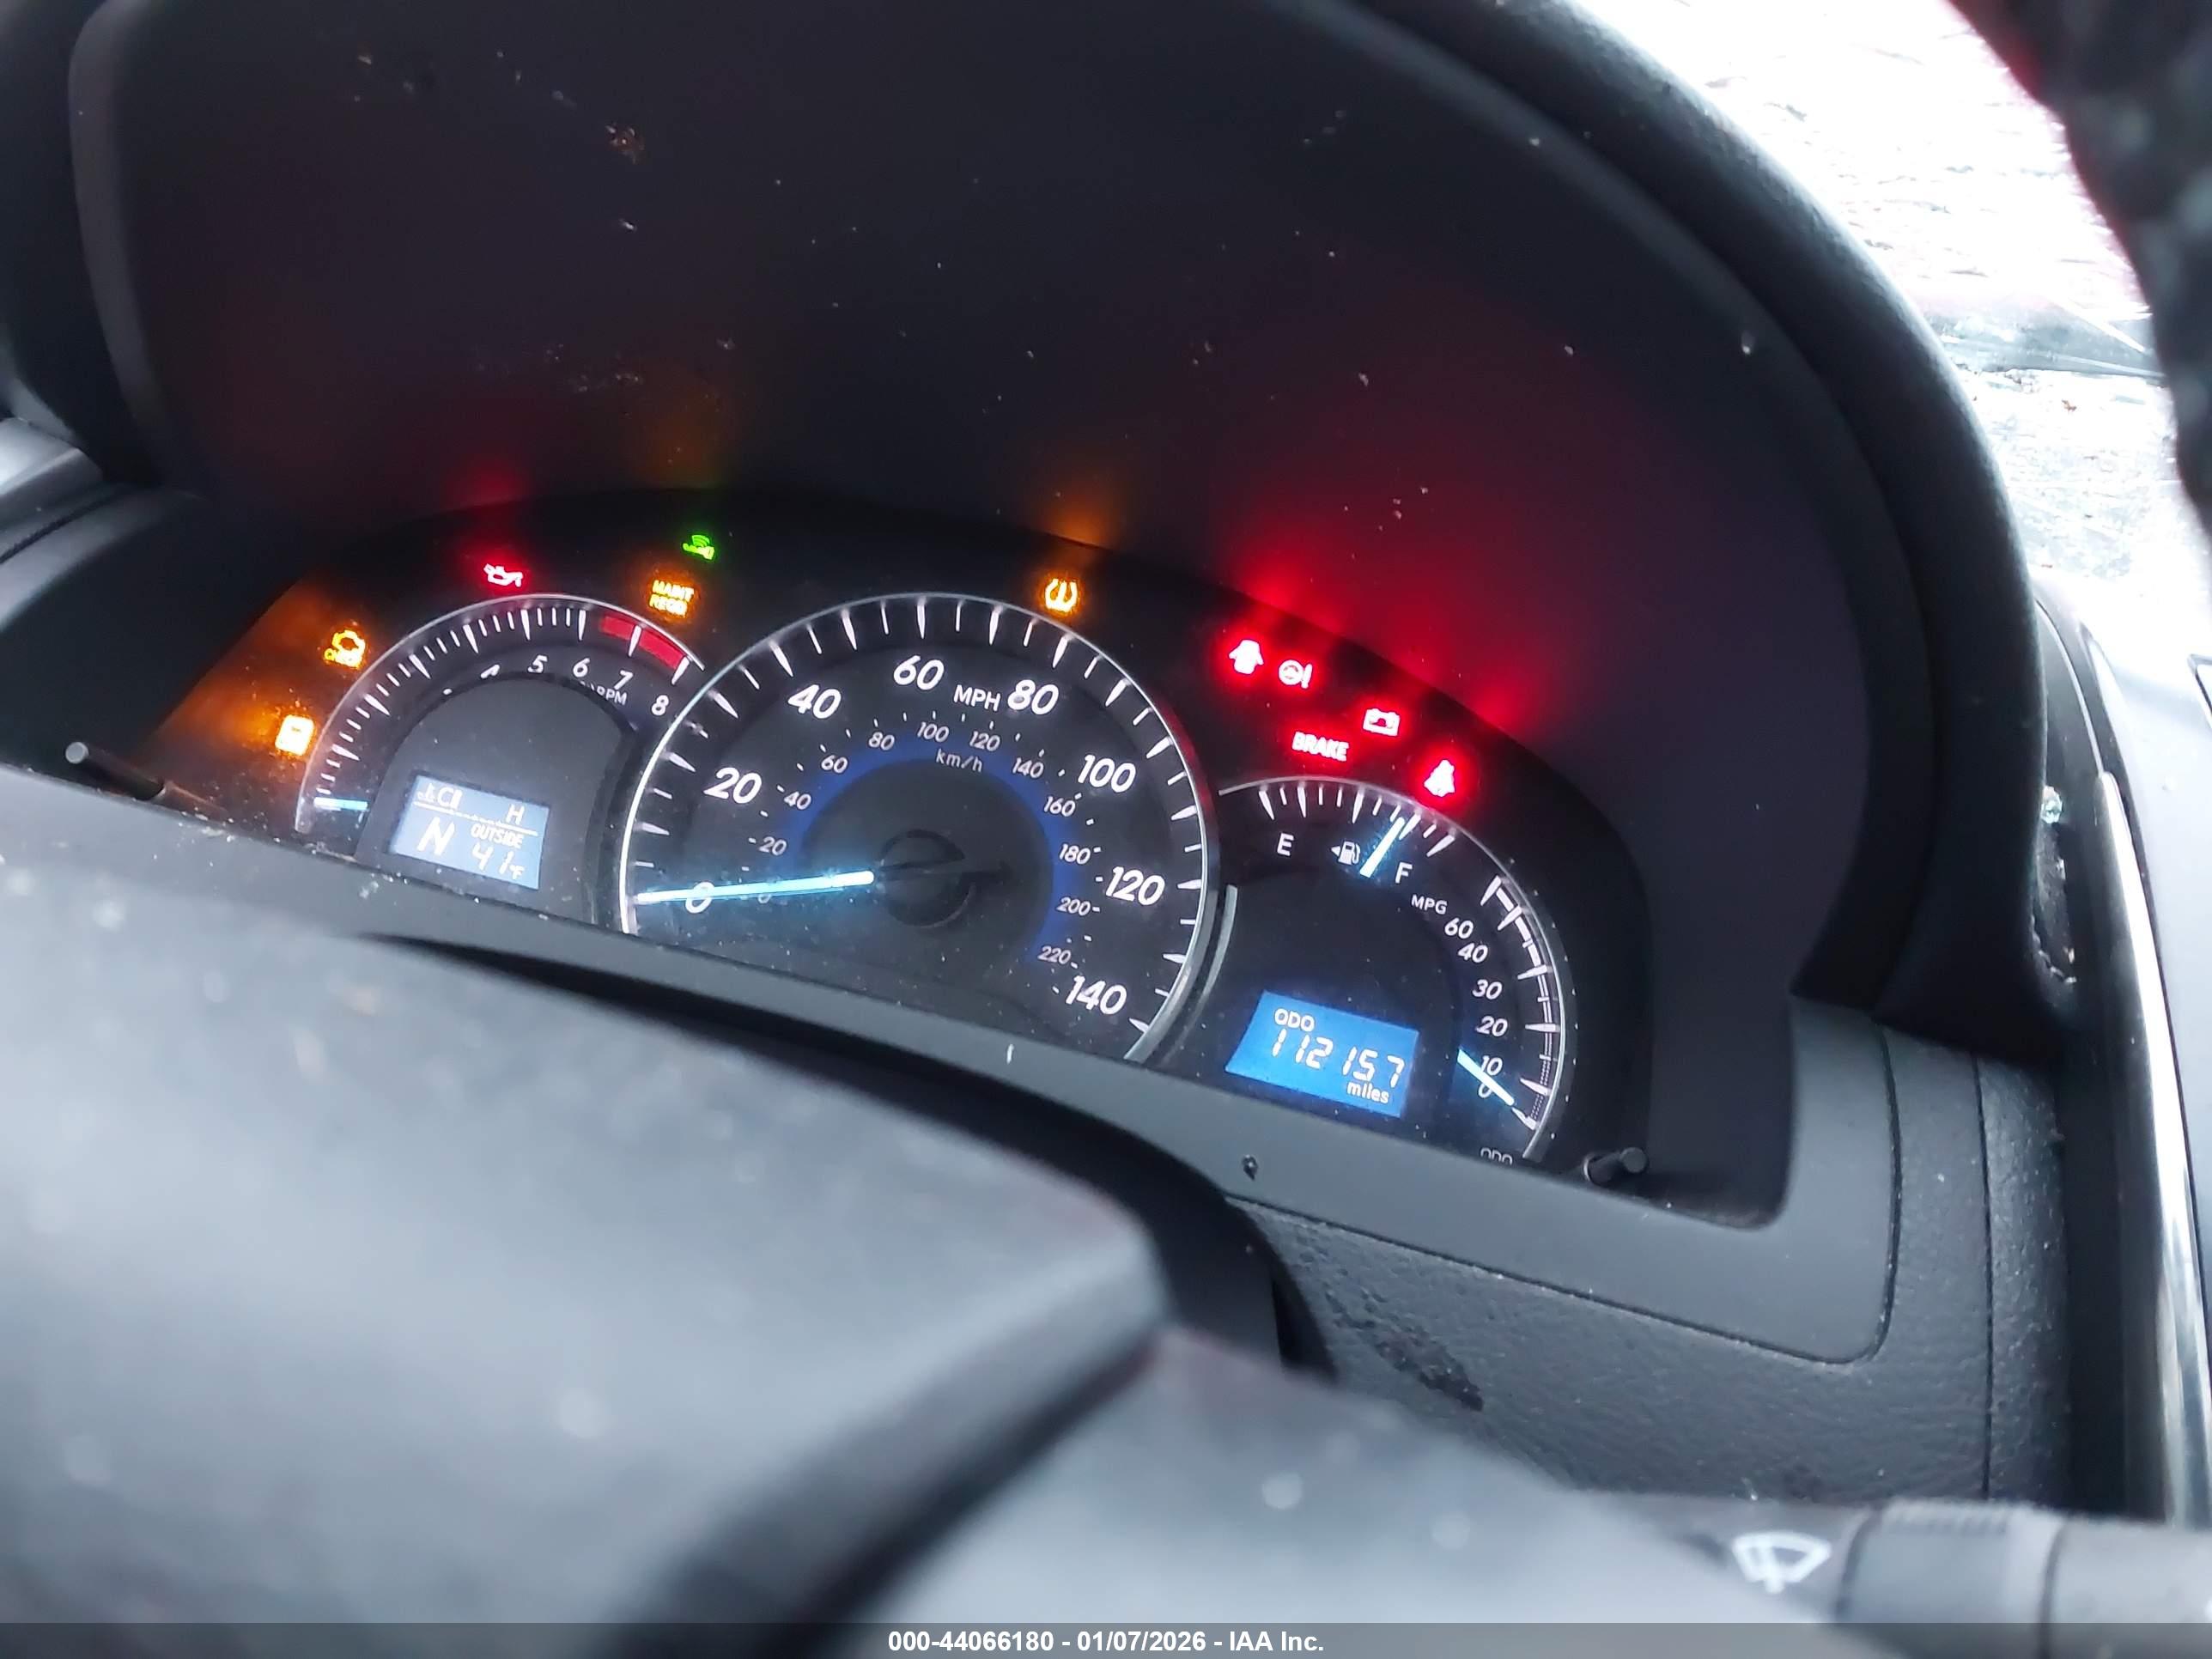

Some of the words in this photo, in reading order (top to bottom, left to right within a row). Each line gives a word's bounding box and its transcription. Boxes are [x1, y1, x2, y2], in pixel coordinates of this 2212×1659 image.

[527, 654, 548, 673] 5
[573, 658, 590, 678] 6
[893, 655, 945, 690] 60
[613, 670, 634, 690] 7
[651, 695, 670, 716] 8
[787, 684, 842, 719] 40
[953, 684, 1001, 712] MPH
[1007, 679, 1060, 715] 80
[868, 732, 895, 750] 80
[917, 721, 950, 743] 100
[969, 731, 1000, 751] 120
[1292, 732, 1349, 762] BRAKE
[821, 755, 848, 774] 60
[936, 748, 982, 772] km/h
[1012, 757, 1044, 778] 140
[1078, 754, 1136, 793] 100
[703, 767, 763, 804] 20
[783, 791, 811, 810] 40
[1043, 796, 1076, 817] 160
[505, 804, 525, 825] H
[416, 816, 455, 857] N
[471, 823, 525, 849] OUTSIDE
[759, 836, 787, 856] 20
[1277, 832, 1294, 856] E
[1059, 843, 1091, 865] 180
[1395, 861, 1413, 884] F
[1105, 866, 1165, 906] 120
[1057, 896, 1091, 916] 200
[1411, 894, 1448, 915] MPG
[1444, 917, 1474, 939] 60
[1037, 945, 1072, 964] 220
[1458, 943, 1488, 963] 40
[1066, 975, 1127, 1015] 140
[1472, 979, 1503, 1000] 30
[1274, 1008, 1315, 1032] ODO
[1476, 1016, 1508, 1037] 20
[1480, 1054, 1503, 1076] 10
[1346, 1082, 1389, 1104] miles
